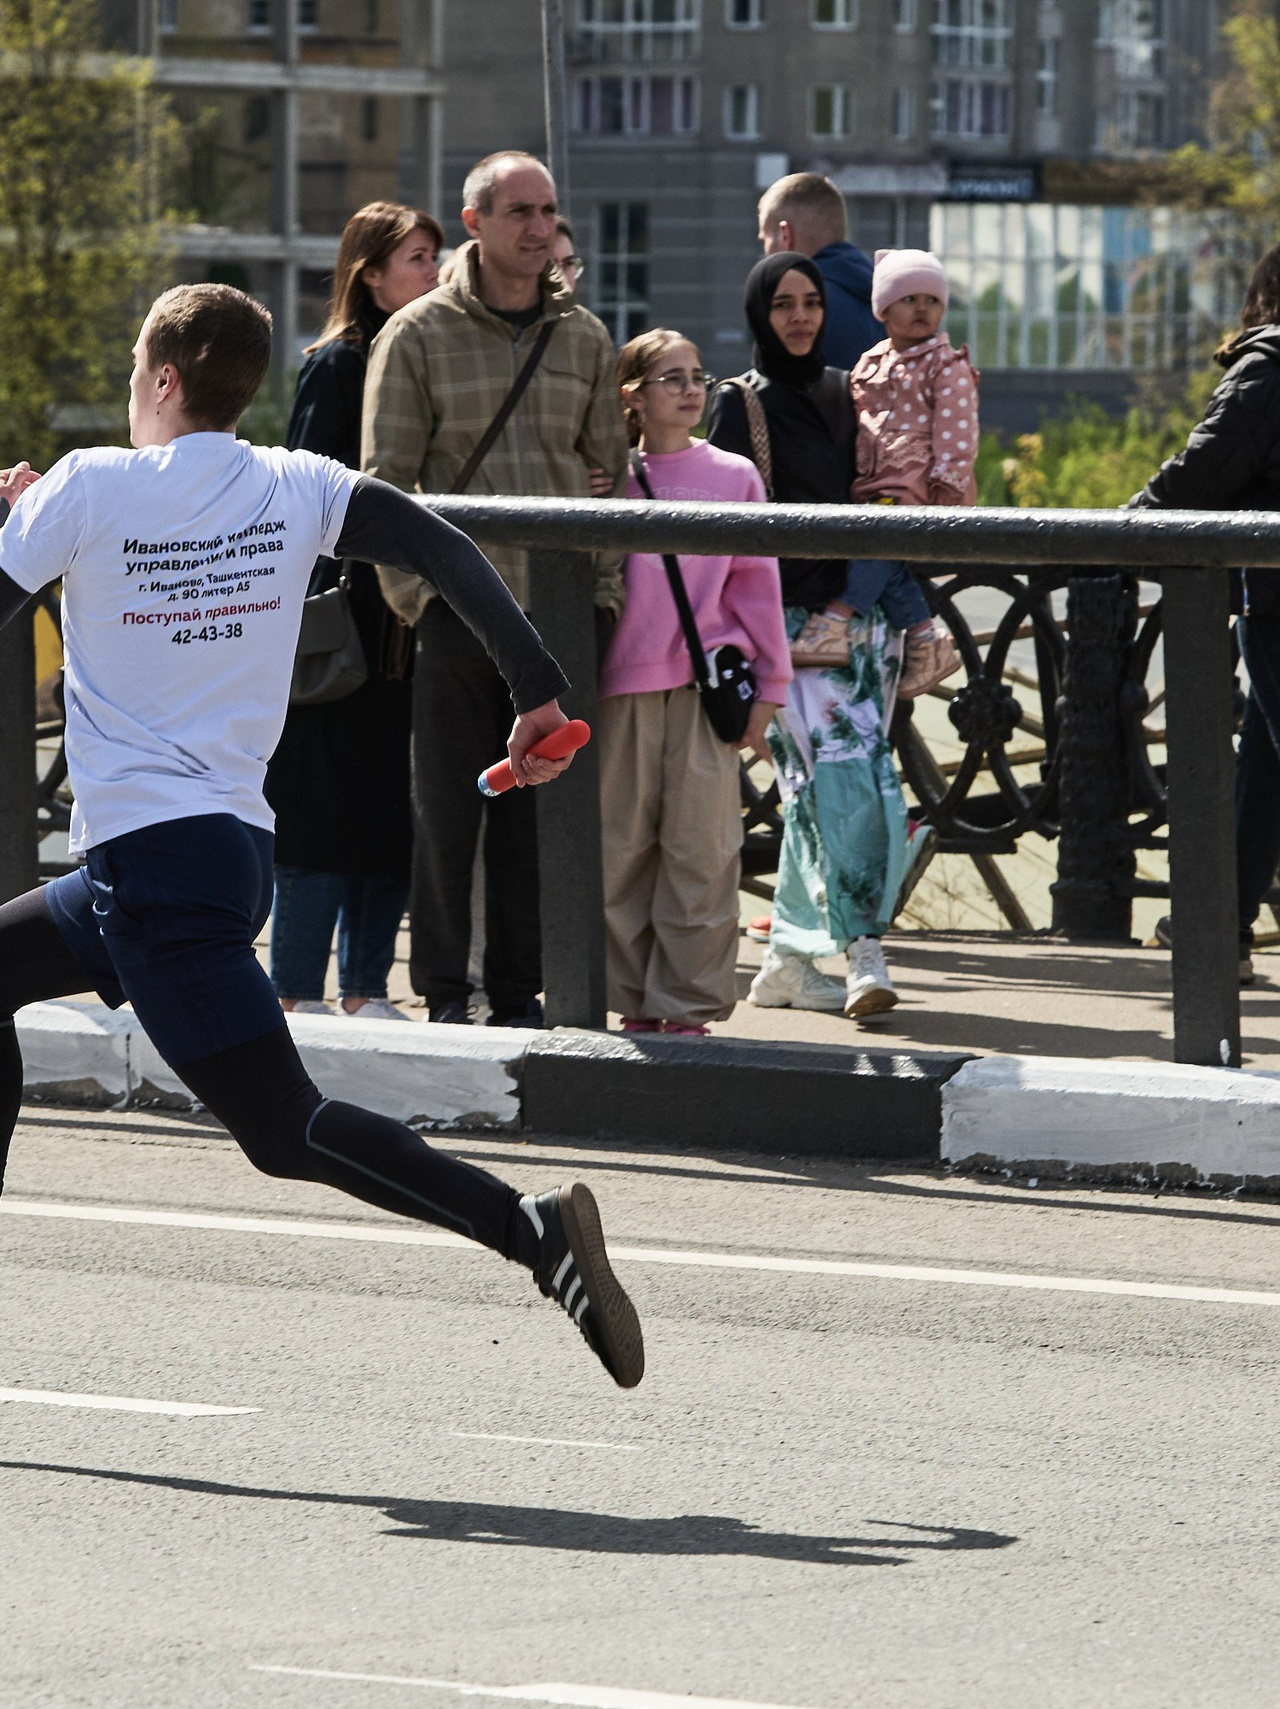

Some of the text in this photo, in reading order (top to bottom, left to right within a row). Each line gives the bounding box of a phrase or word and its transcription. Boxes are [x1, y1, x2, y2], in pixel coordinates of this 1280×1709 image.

[122, 536, 224, 555] Ивановский
[225, 548, 236, 560] и
[239, 539, 284, 559] права
[138, 566, 275, 593] г. Иваново, Ташкентская
[167, 593, 179, 602] д.
[182, 588, 199, 600] 90
[201, 585, 234, 599] литер
[122, 596, 281, 627] Поступай правильно!
[171, 622, 243, 645] 42-43-38
